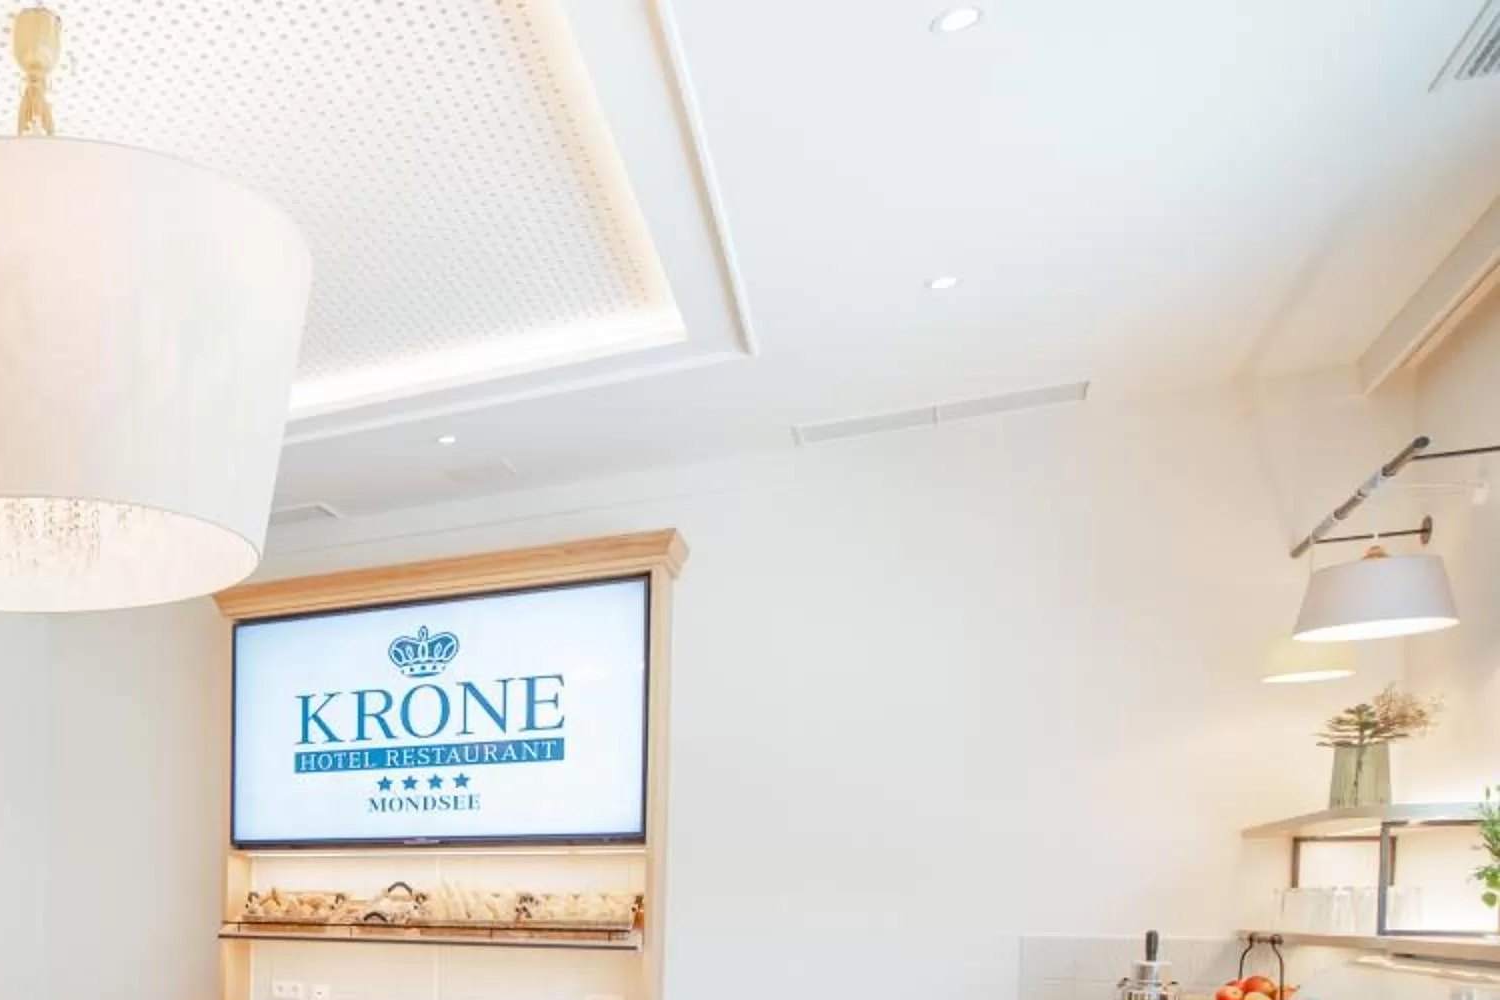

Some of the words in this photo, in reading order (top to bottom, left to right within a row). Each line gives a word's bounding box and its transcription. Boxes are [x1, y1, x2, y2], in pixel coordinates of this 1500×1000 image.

[294, 674, 565, 745] KRONE
[300, 751, 376, 772] HOTEL
[386, 740, 557, 768] RESTAURANT
[367, 793, 481, 813] MONDSEE
